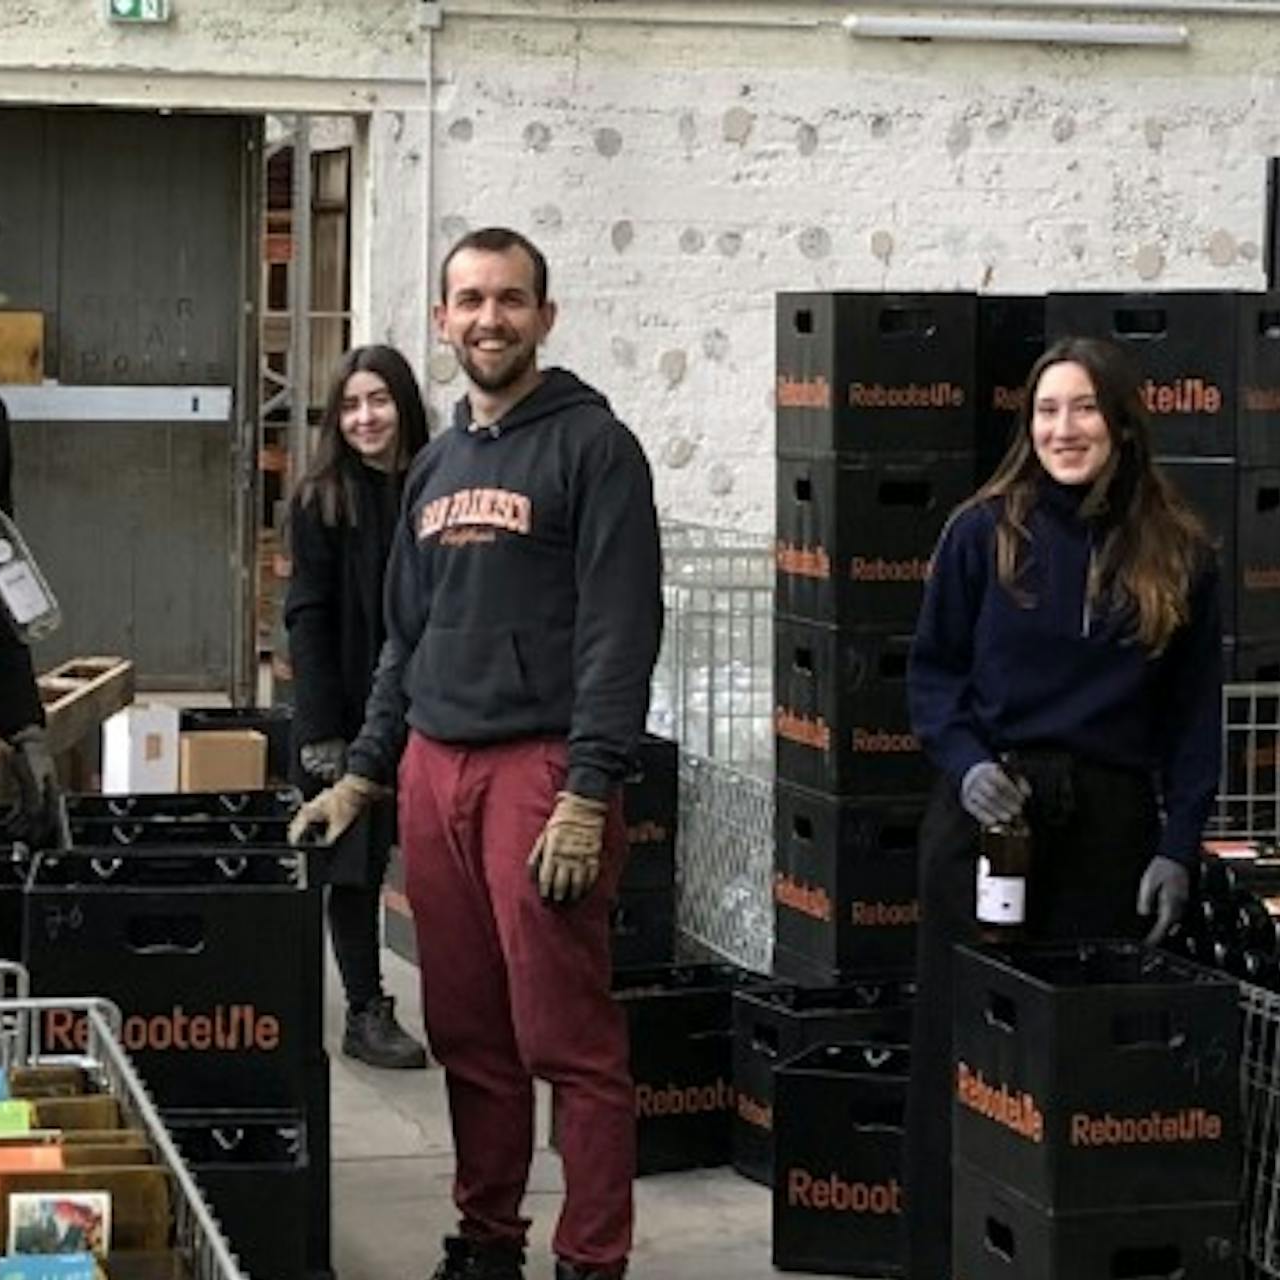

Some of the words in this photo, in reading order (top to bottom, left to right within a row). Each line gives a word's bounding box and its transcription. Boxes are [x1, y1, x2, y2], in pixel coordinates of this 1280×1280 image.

[848, 381, 965, 408] Rebooteille
[1138, 378, 1223, 414] teille
[46, 1004, 281, 1050] Reooteille
[1072, 1109, 1222, 1146] Rebooteille
[787, 1167, 903, 1214] Reboot
